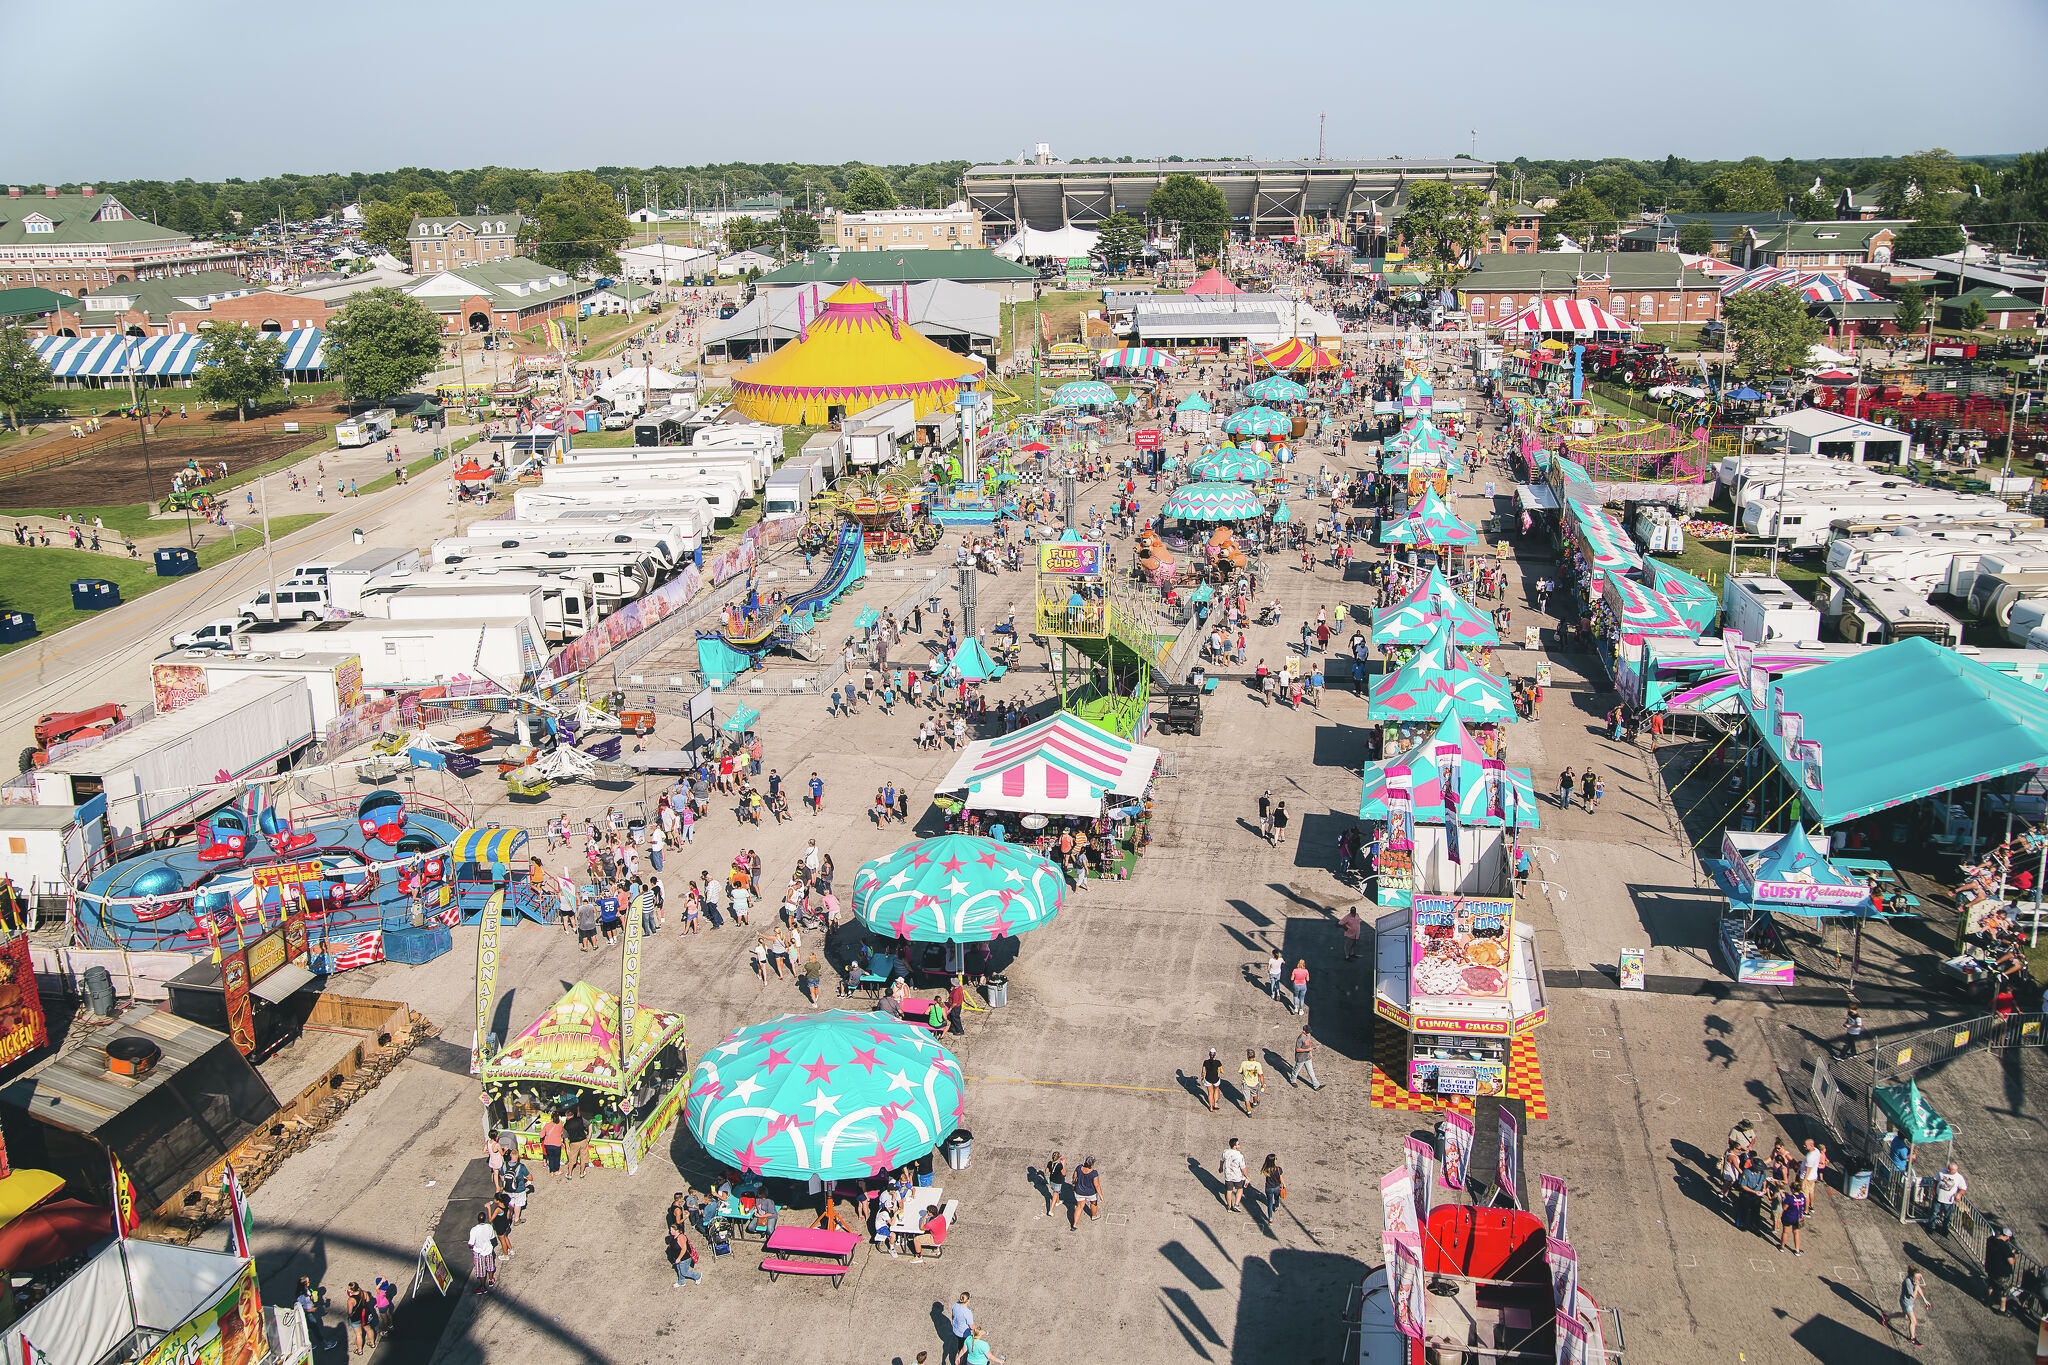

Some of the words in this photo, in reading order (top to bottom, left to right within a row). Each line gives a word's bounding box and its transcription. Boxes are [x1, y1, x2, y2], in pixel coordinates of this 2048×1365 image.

[1046, 557, 1081, 569] SLIDE
[1050, 548, 1078, 559] FUN
[172, 690, 187, 699] We
[1759, 883, 1802, 898] GUEST
[1805, 886, 1864, 901] Relations
[1416, 899, 1456, 913] FUNNEL
[1464, 901, 1513, 916] ELEPHANT
[1417, 913, 1454, 926] CAKES
[1474, 916, 1501, 930] EARS
[256, 939, 276, 959] JUMBO
[250, 957, 272, 978] TURKEY
[271, 947, 285, 967] LEGS
[479, 901, 499, 1030] LEMONADE
[623, 907, 641, 1037] LEMONADE
[1378, 1005, 1408, 1025] DRINKS
[1516, 1015, 1544, 1031] DRINKS
[1419, 1019, 1462, 1029] FUNNEL
[1465, 1023, 1505, 1032] CAKES
[0, 1024, 34, 1060] HICKEN
[521, 1033, 600, 1062] LEMONADE
[485, 1068, 554, 1080] STRAWBERRY
[559, 1072, 619, 1090] LEMONADE
